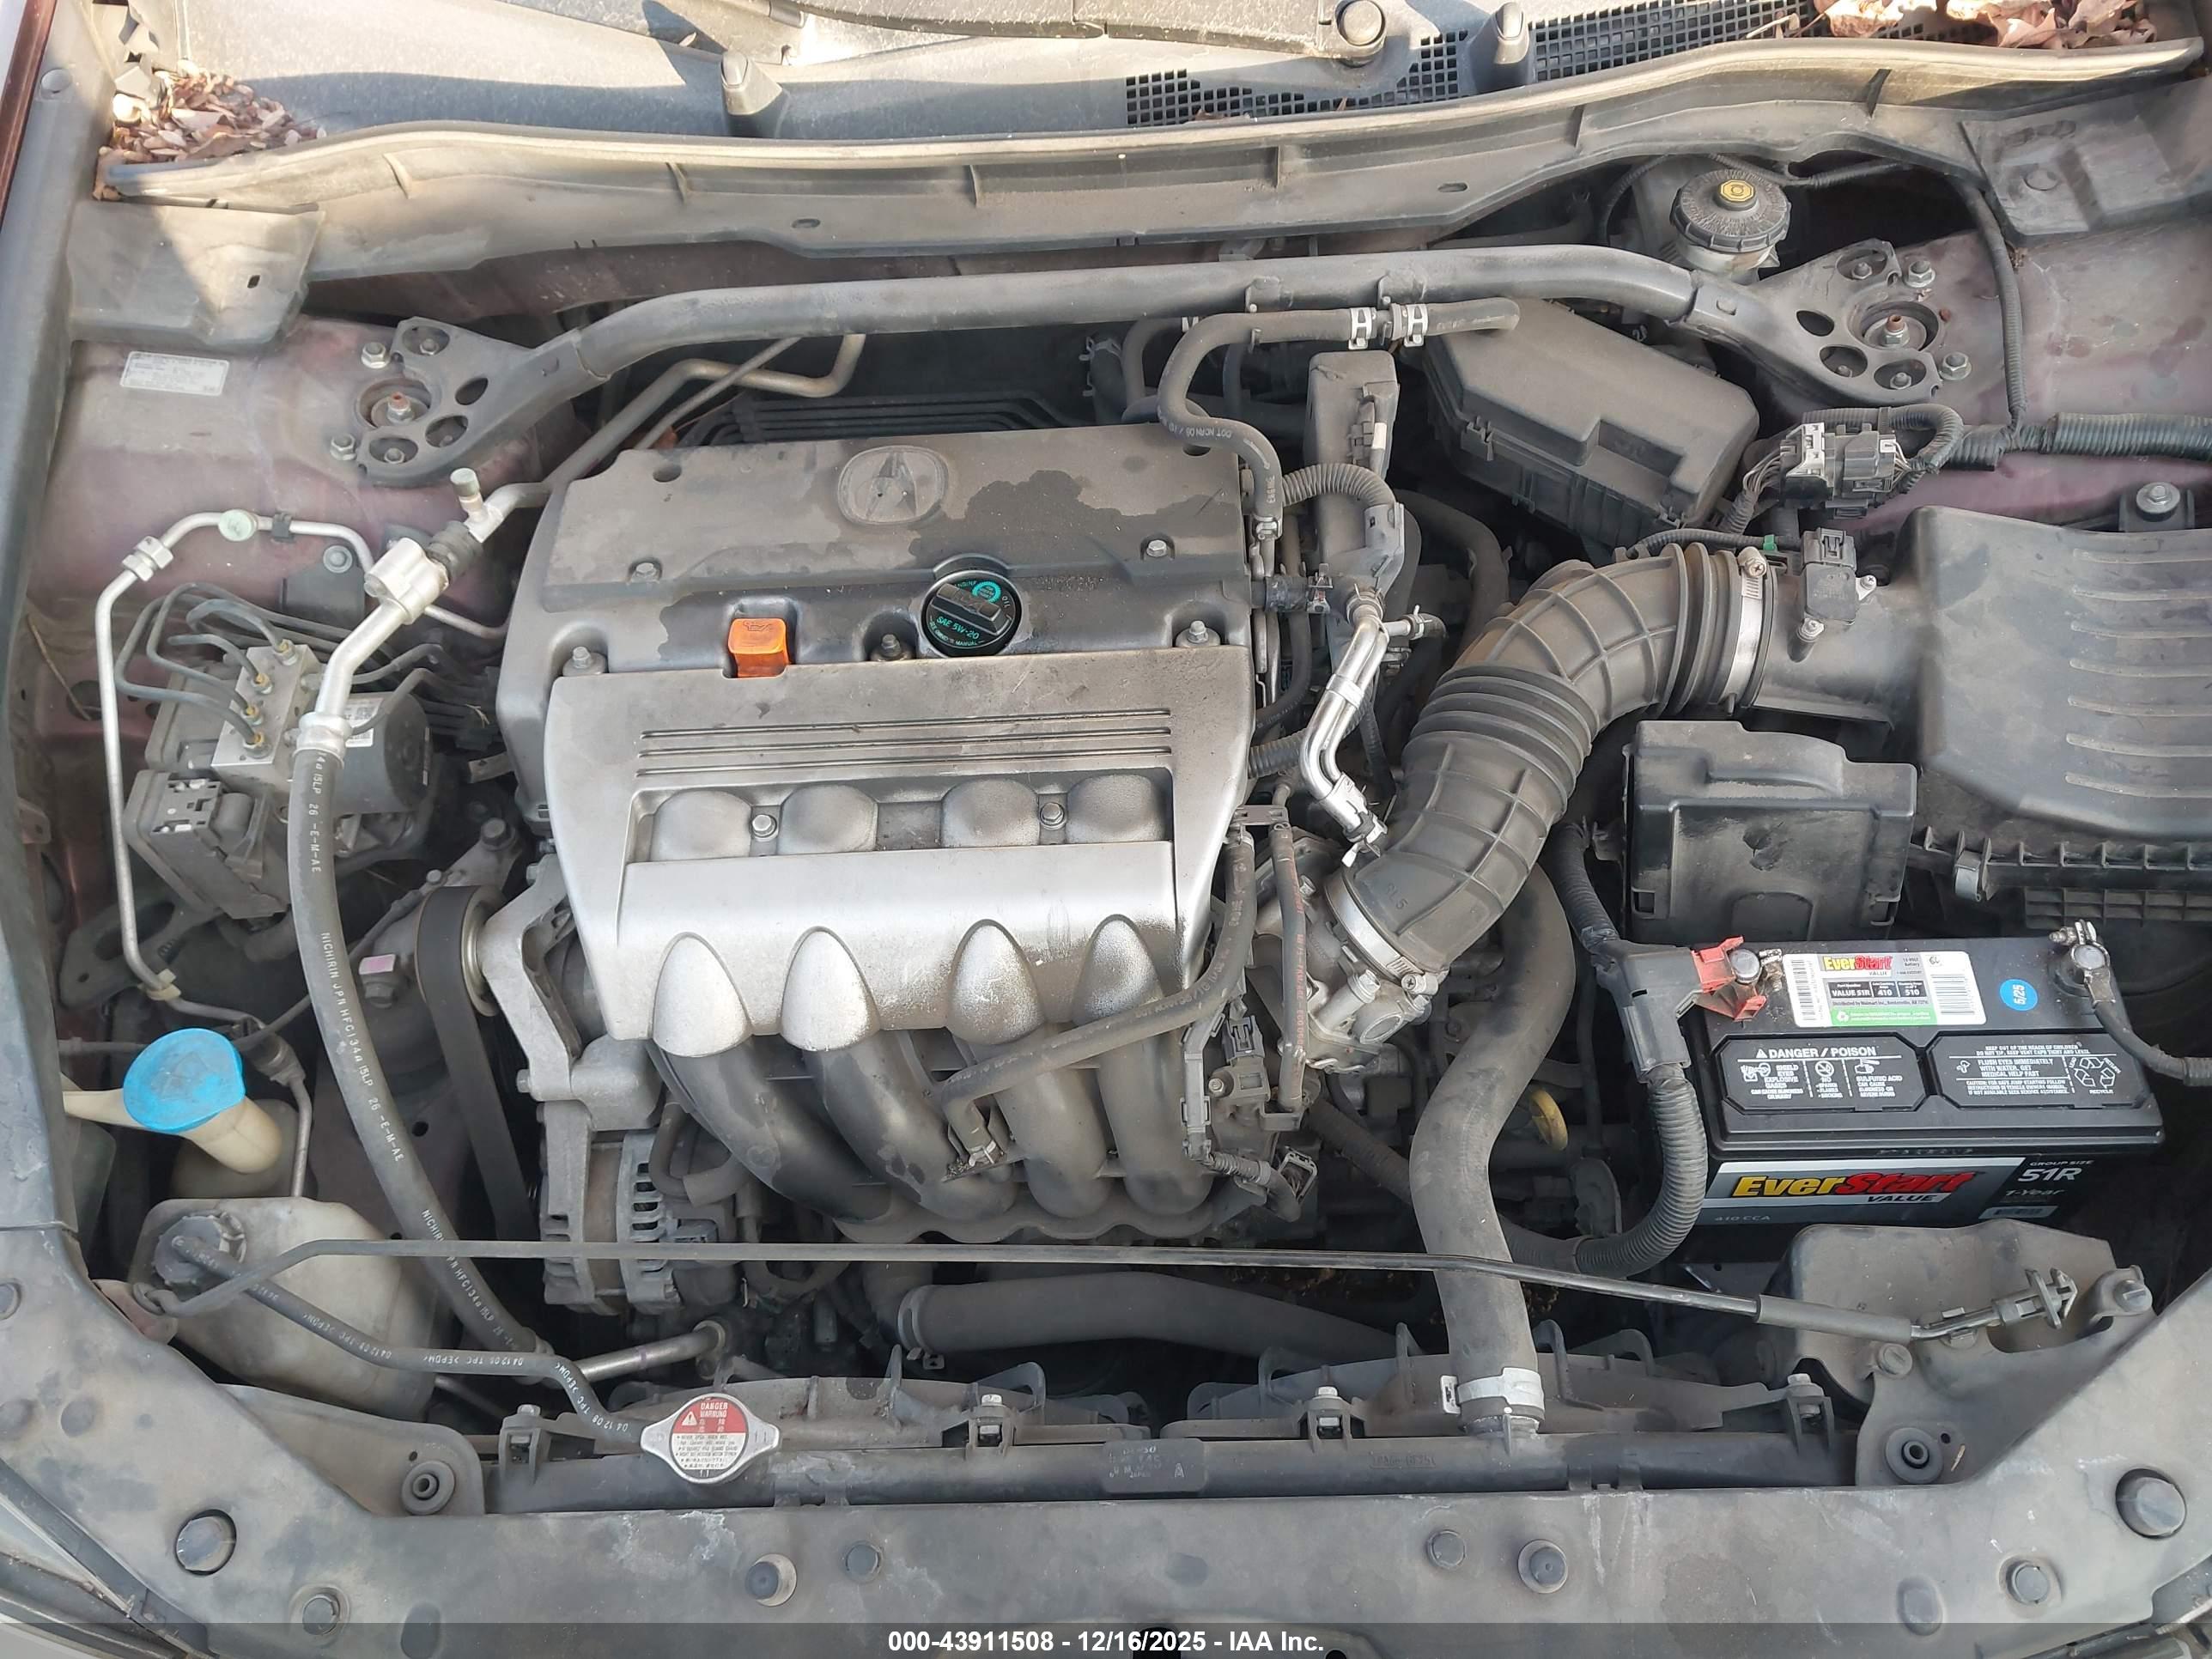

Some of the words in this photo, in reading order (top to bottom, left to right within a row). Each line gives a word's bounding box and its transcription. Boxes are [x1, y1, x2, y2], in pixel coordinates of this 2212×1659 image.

[1001, 595, 1011, 609] OIL
[936, 616, 953, 628] SAE
[952, 620, 980, 641] 5W-20
[321, 932, 339, 979] NICHIRIN
[332, 983, 346, 1008] JPN
[1823, 954, 1893, 971] EverStart
[1768, 1048, 1819, 1059] DANGER
[1820, 1048, 1829, 1058] /
[1831, 1046, 1876, 1057] POISON
[2017, 1167, 2082, 1182] 51R
[1731, 1172, 1977, 1198] EverStart
[466, 1355, 483, 1364] TPC
[577, 1395, 590, 1414] TPC
[700, 1401, 728, 1410] DANGER
